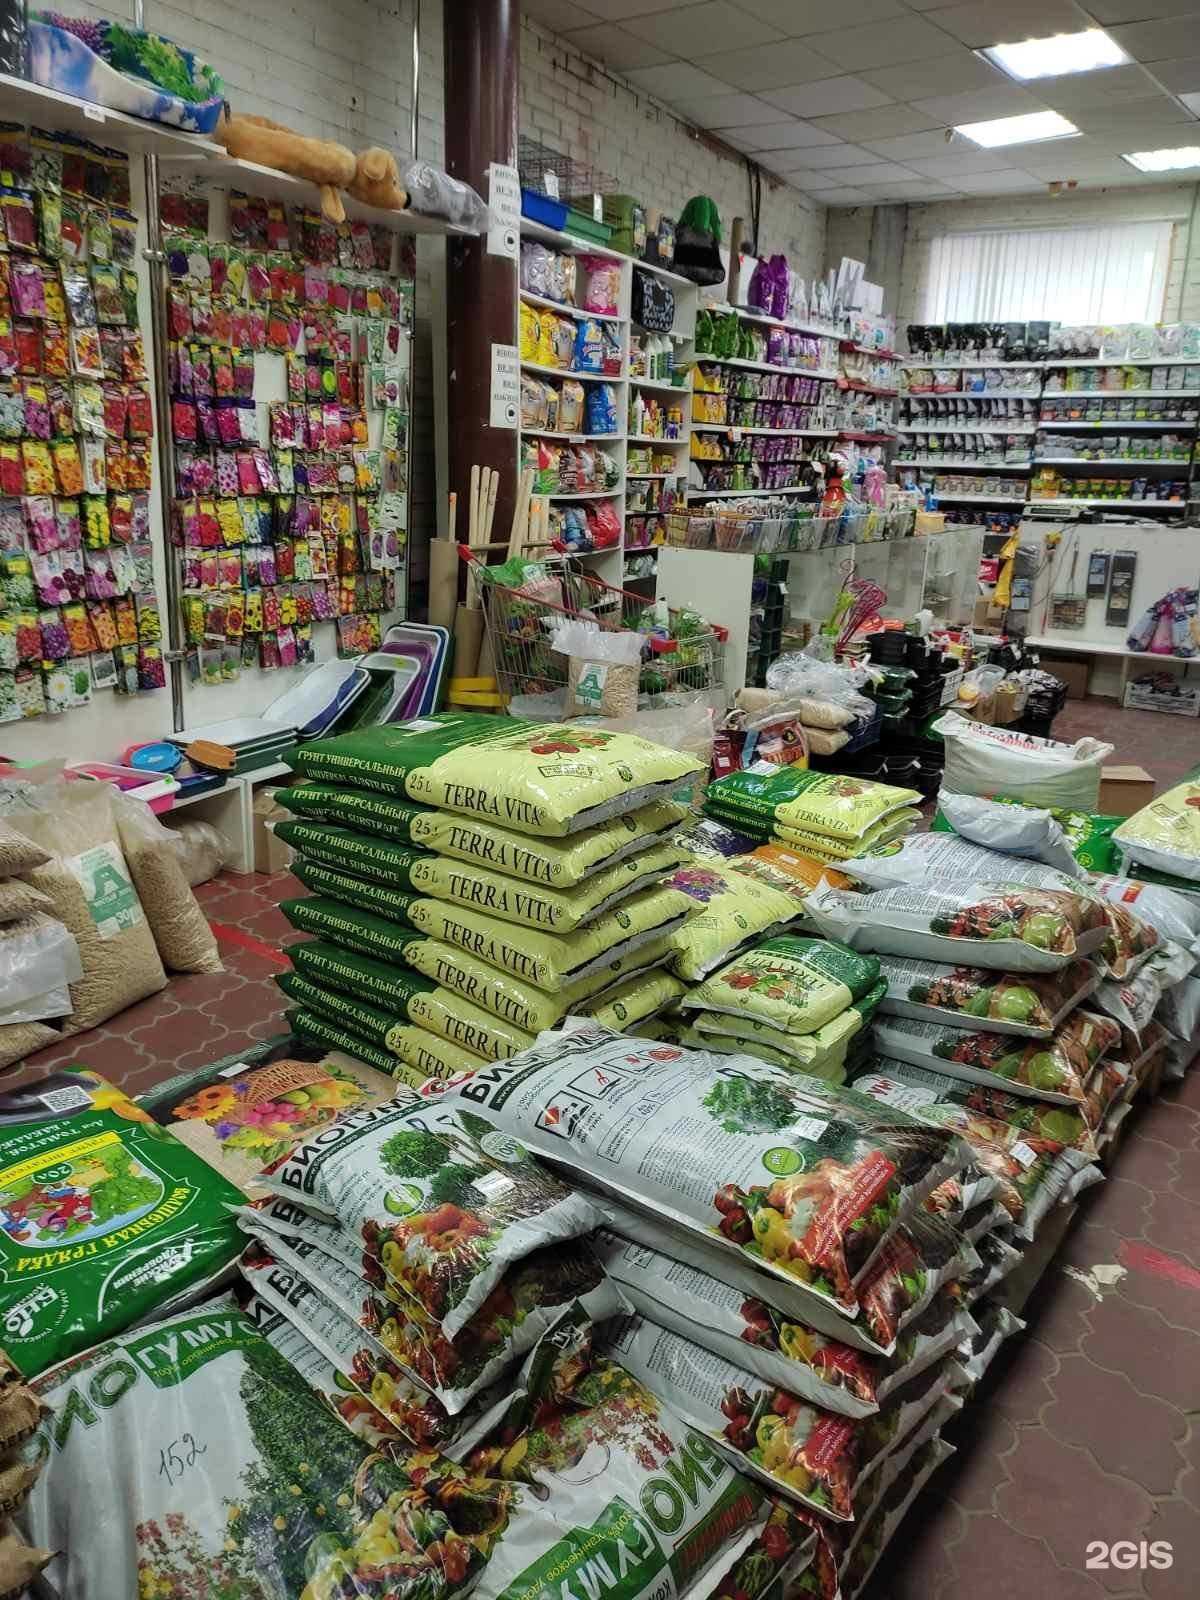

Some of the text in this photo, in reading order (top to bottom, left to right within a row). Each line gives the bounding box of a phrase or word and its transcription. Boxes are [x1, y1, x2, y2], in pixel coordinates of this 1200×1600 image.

[298, 751, 325, 760] ГРУНТ
[293, 790, 323, 800] ГРУНТ
[444, 783, 501, 816] TERRA
[293, 826, 324, 841] ГРУНТ
[449, 827, 506, 865] TERRA
[305, 865, 330, 881] ГРУНТ
[449, 874, 509, 912] TERRA
[294, 905, 321, 920] ГРУНТ
[441, 919, 497, 960] TERRA
[299, 950, 327, 967] ГРУНТ
[291, 977, 315, 995] ГРУНТ
[436, 959, 488, 1006] TERRA
[444, 1015, 499, 1058] TERRA
[16, 1186, 190, 1272] ВОЛШЕБНАЯ ГРЯДКА
[158, 1432, 207, 1487] 152
